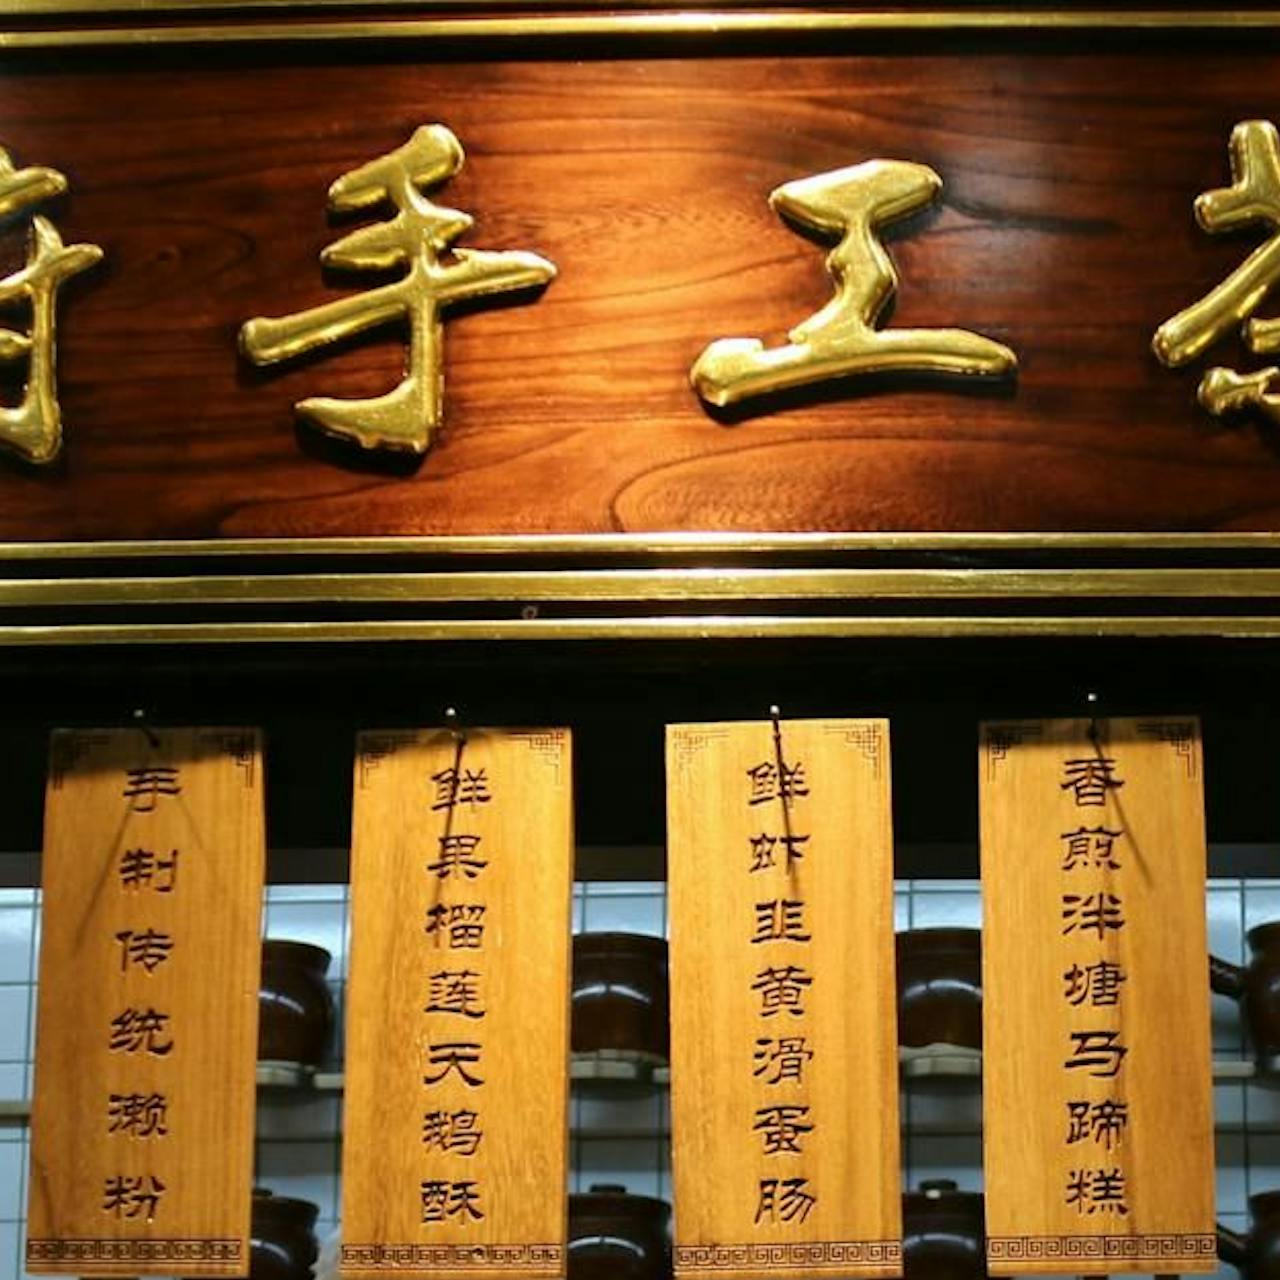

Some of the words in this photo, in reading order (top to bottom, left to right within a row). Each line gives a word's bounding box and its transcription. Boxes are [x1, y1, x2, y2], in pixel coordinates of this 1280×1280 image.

[102, 766, 181, 1226] 手制传统濑粉
[420, 767, 493, 1226] 鲜果榴莲天鹅酥
[746, 760, 817, 1226] 鲜虾韭黄滑蛋肠
[1060, 757, 1129, 1218] 香煎泮塘马蹄糕
